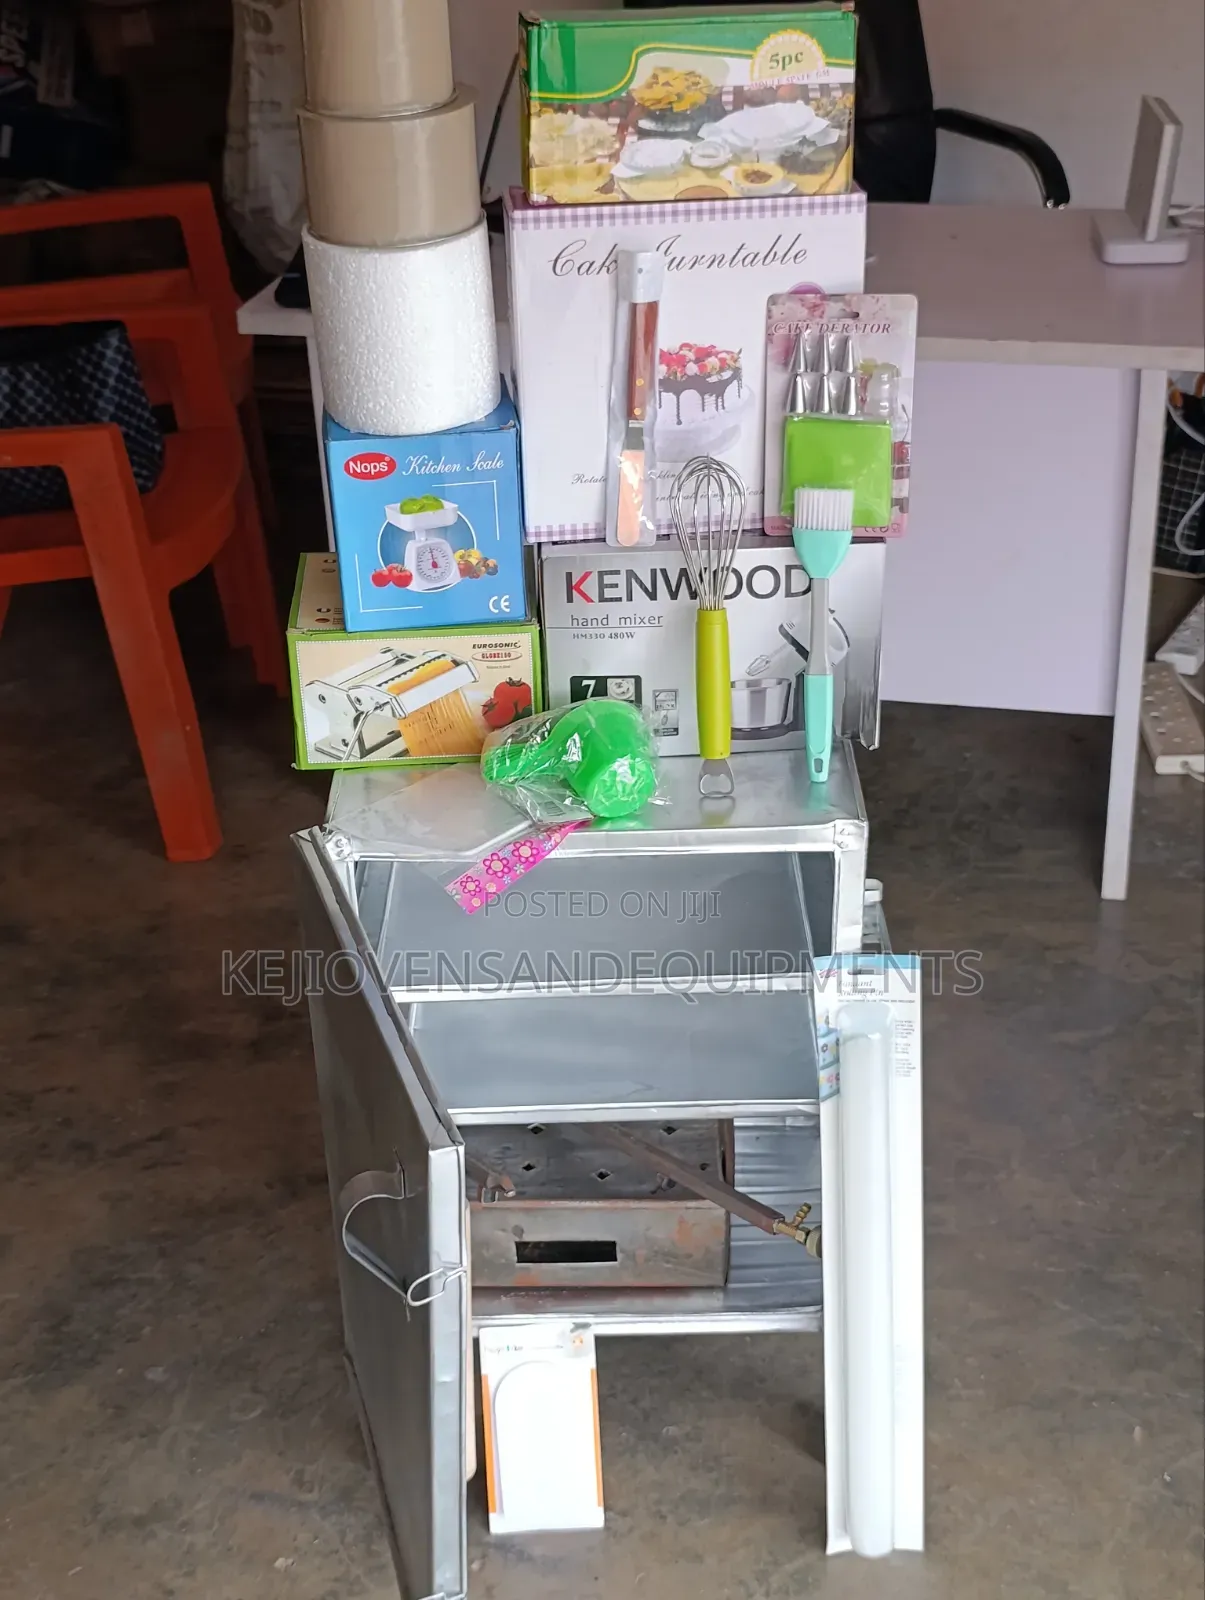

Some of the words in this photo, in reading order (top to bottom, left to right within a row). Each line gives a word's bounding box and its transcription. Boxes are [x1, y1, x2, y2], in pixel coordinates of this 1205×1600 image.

[769, 52, 803, 71] 5pc
[548, 239, 618, 277] Cak
[656, 233, 808, 271] Turntable
[349, 460, 388, 475] Nops
[402, 455, 462, 476] Kitchen
[467, 450, 504, 471] Scale
[565, 564, 812, 604] KENWOOD
[489, 595, 511, 613] CE
[571, 614, 609, 627] hand
[618, 613, 664, 625] mixer
[572, 632, 605, 640] HM330
[608, 631, 636, 640] 480W
[472, 641, 521, 650] EUROSONIC
[581, 679, 596, 699] 7
